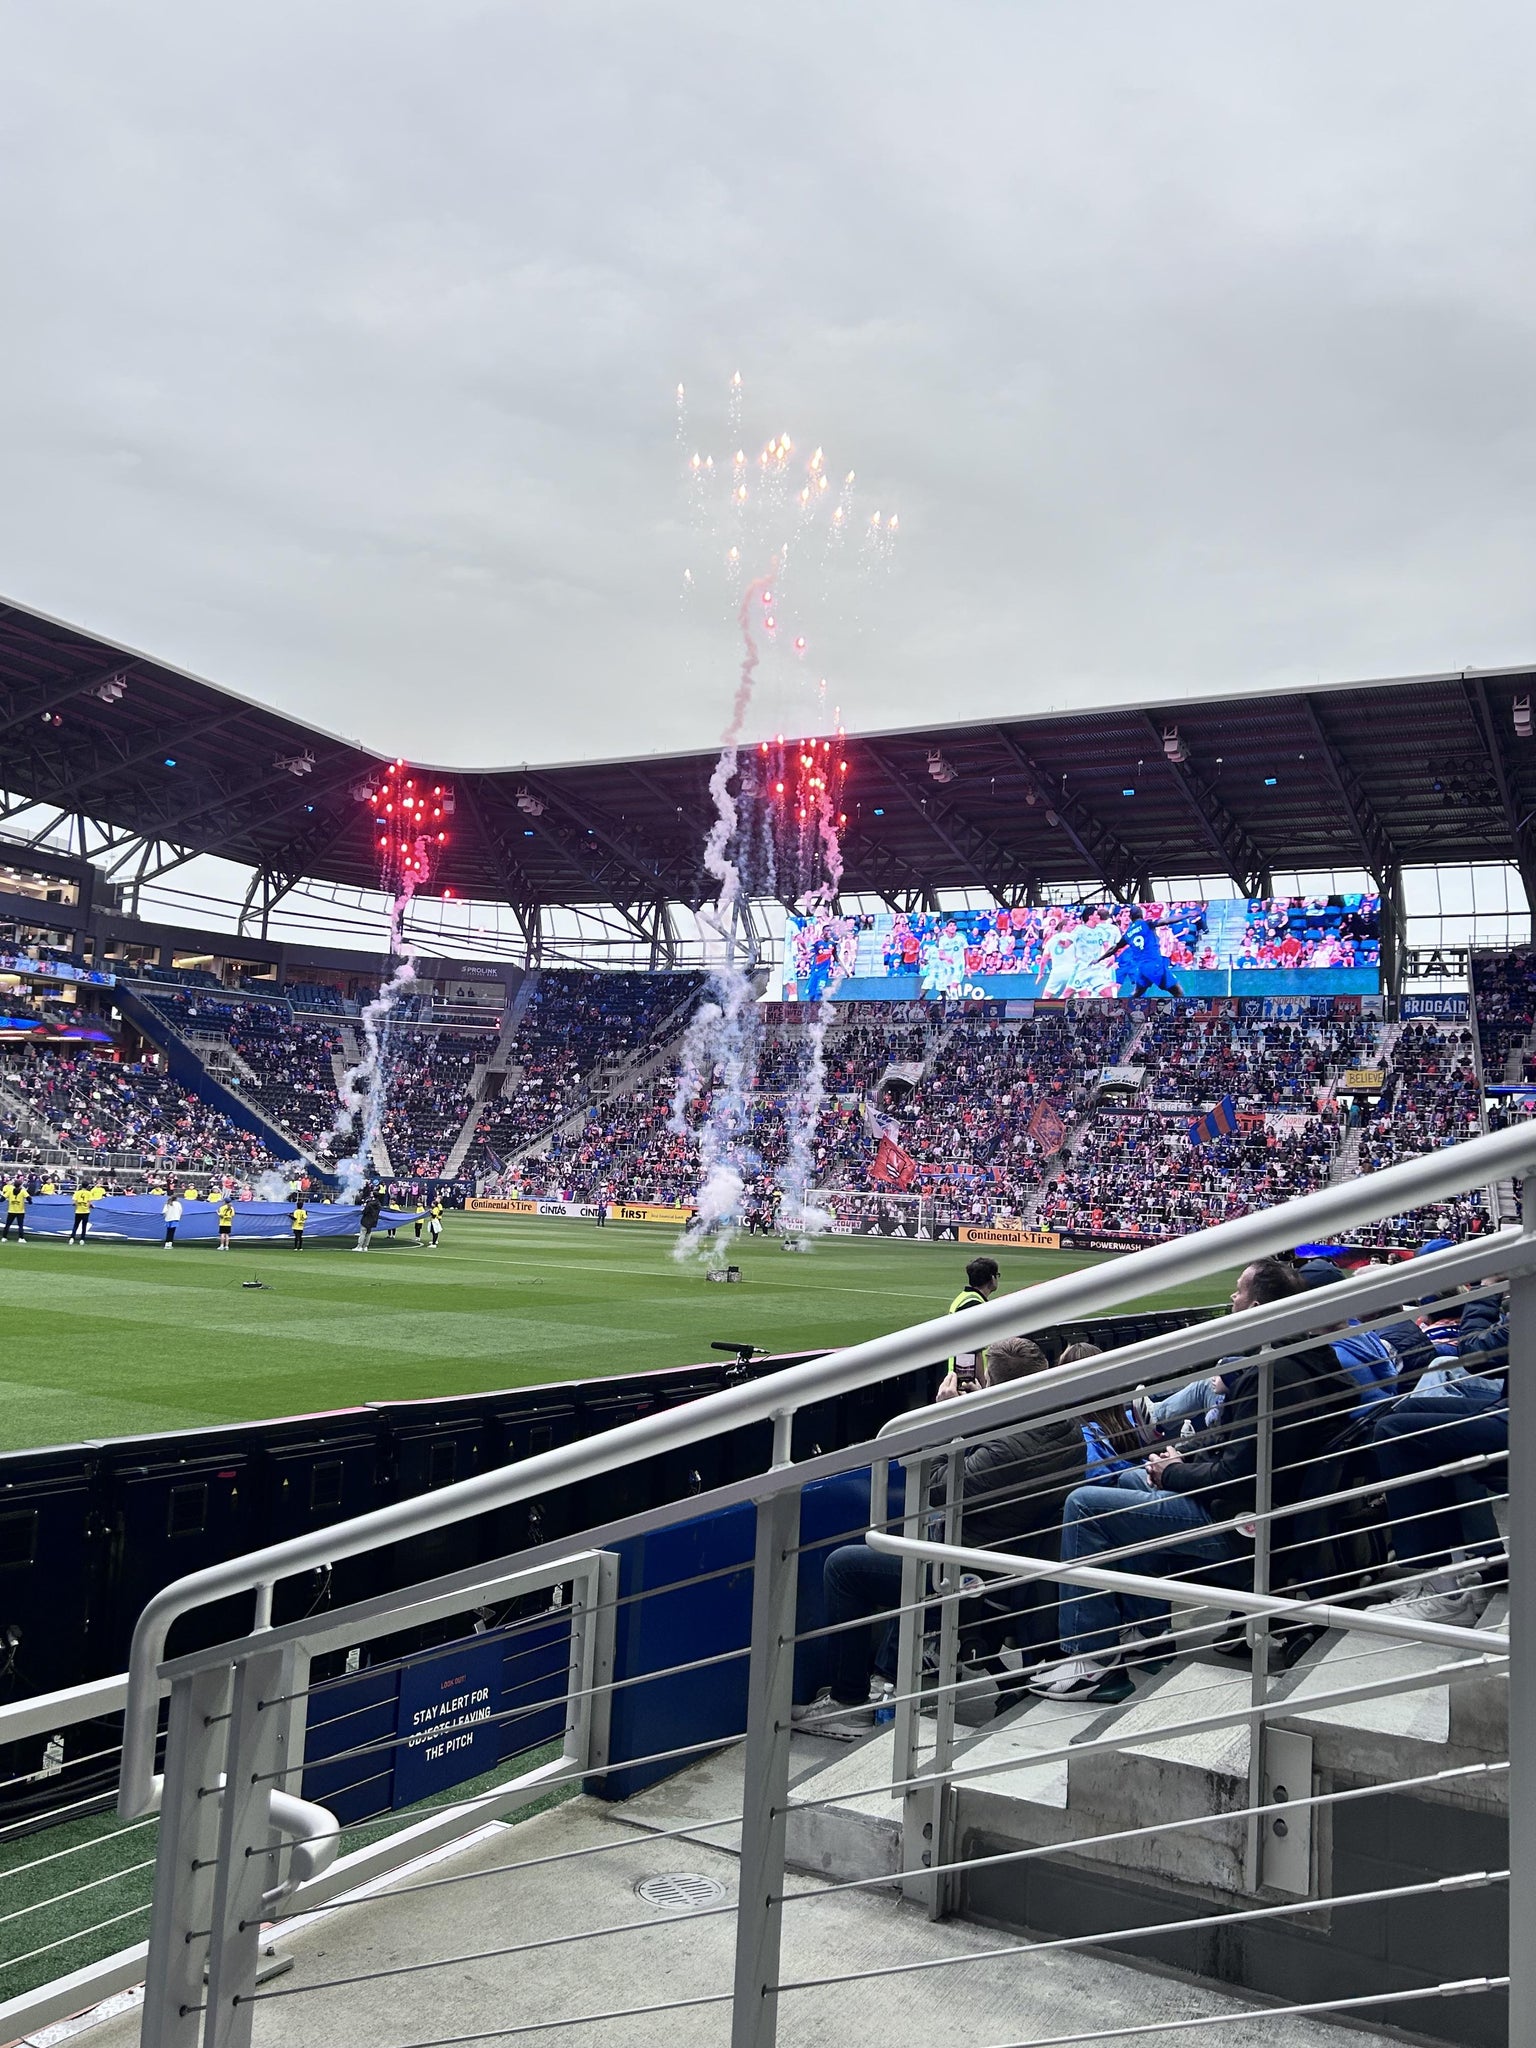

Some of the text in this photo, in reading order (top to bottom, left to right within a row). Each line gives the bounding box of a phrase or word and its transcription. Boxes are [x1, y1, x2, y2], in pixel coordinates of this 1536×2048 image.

[1349, 1071, 1383, 1083] BELIEVE
[471, 1199, 533, 1211] Continental Tire
[967, 1229, 1020, 1243] Continental
[1029, 1233, 1053, 1244] Tire
[1090, 1240, 1141, 1251] POWERWASH
[413, 1687, 489, 1725] STAY ALERT FOR
[425, 1732, 474, 1761] THE PITCH
